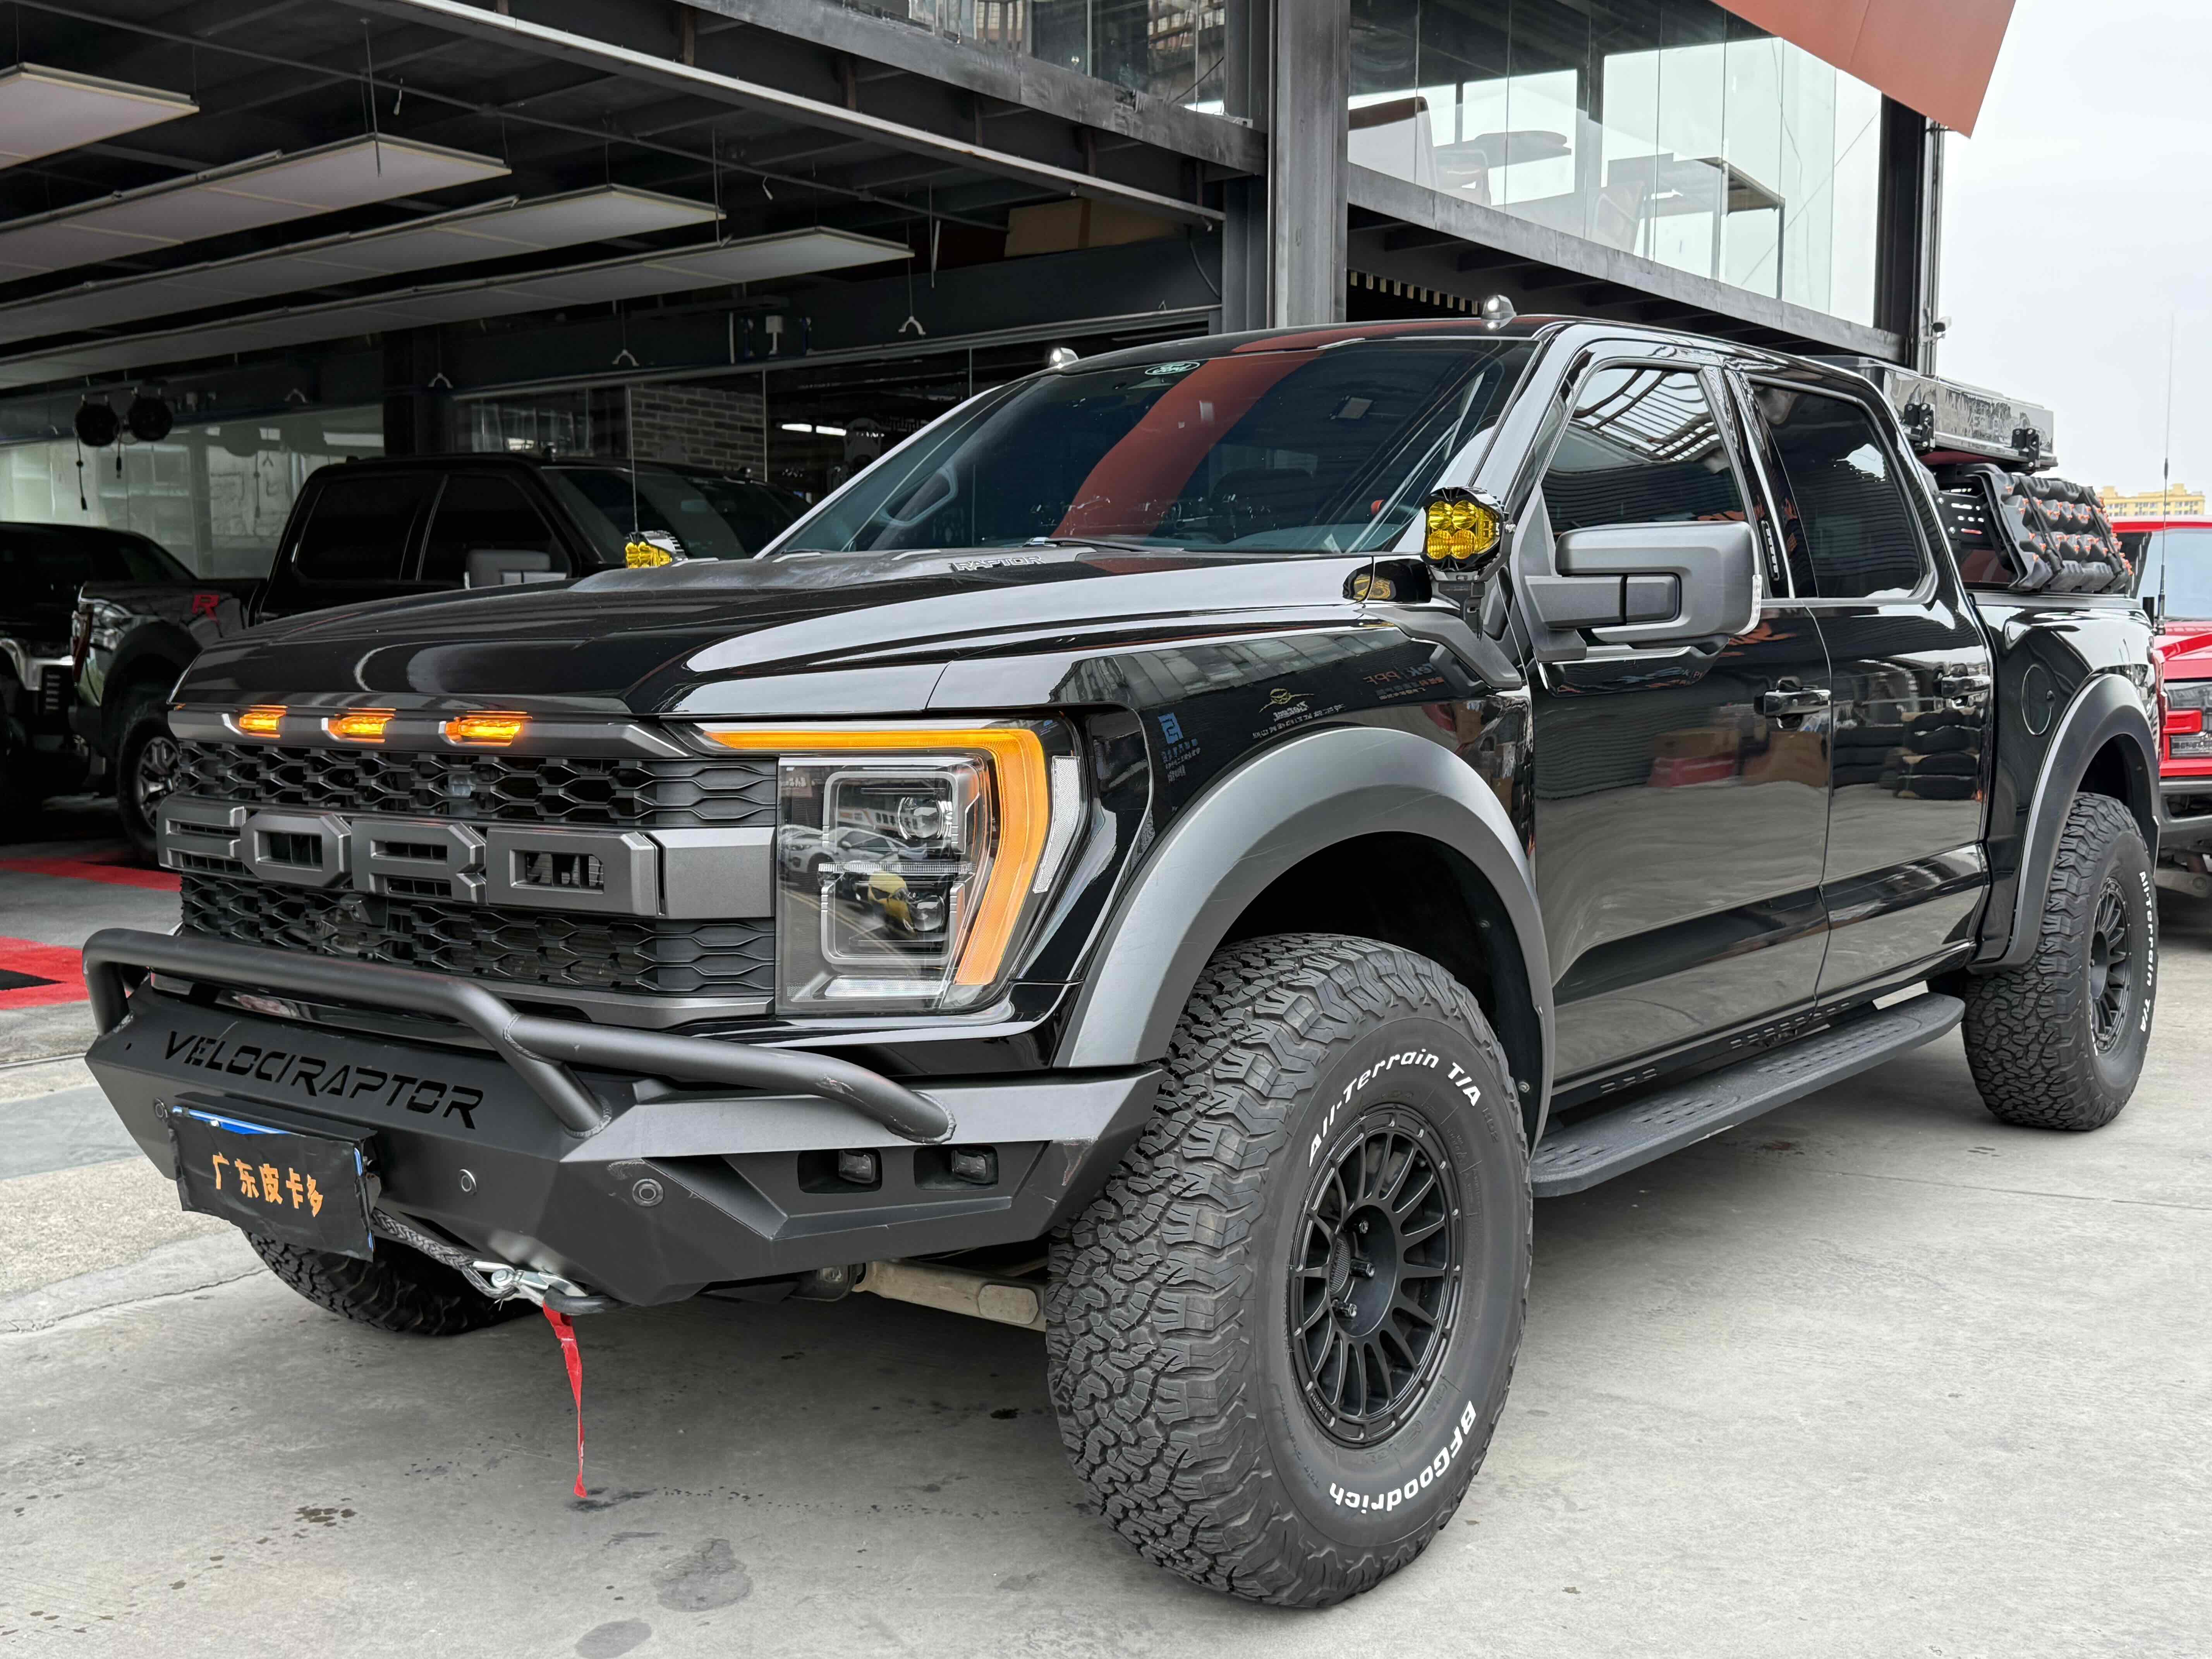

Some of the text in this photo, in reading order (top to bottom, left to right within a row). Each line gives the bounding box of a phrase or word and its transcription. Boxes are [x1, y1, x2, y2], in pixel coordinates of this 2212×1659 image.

[950, 555, 1046, 573] RAPTOR
[156, 794, 658, 919] FORD
[2138, 871, 2154, 1032] All-Terrain T/A
[165, 1030, 484, 1129] VELOCIRAPTOR
[1307, 1048, 1440, 1168] All-Terrain
[1447, 1061, 1482, 1107] T/A
[212, 1152, 324, 1218] 广东皮卡多
[1329, 1401, 1477, 1515] BFGoodrich
